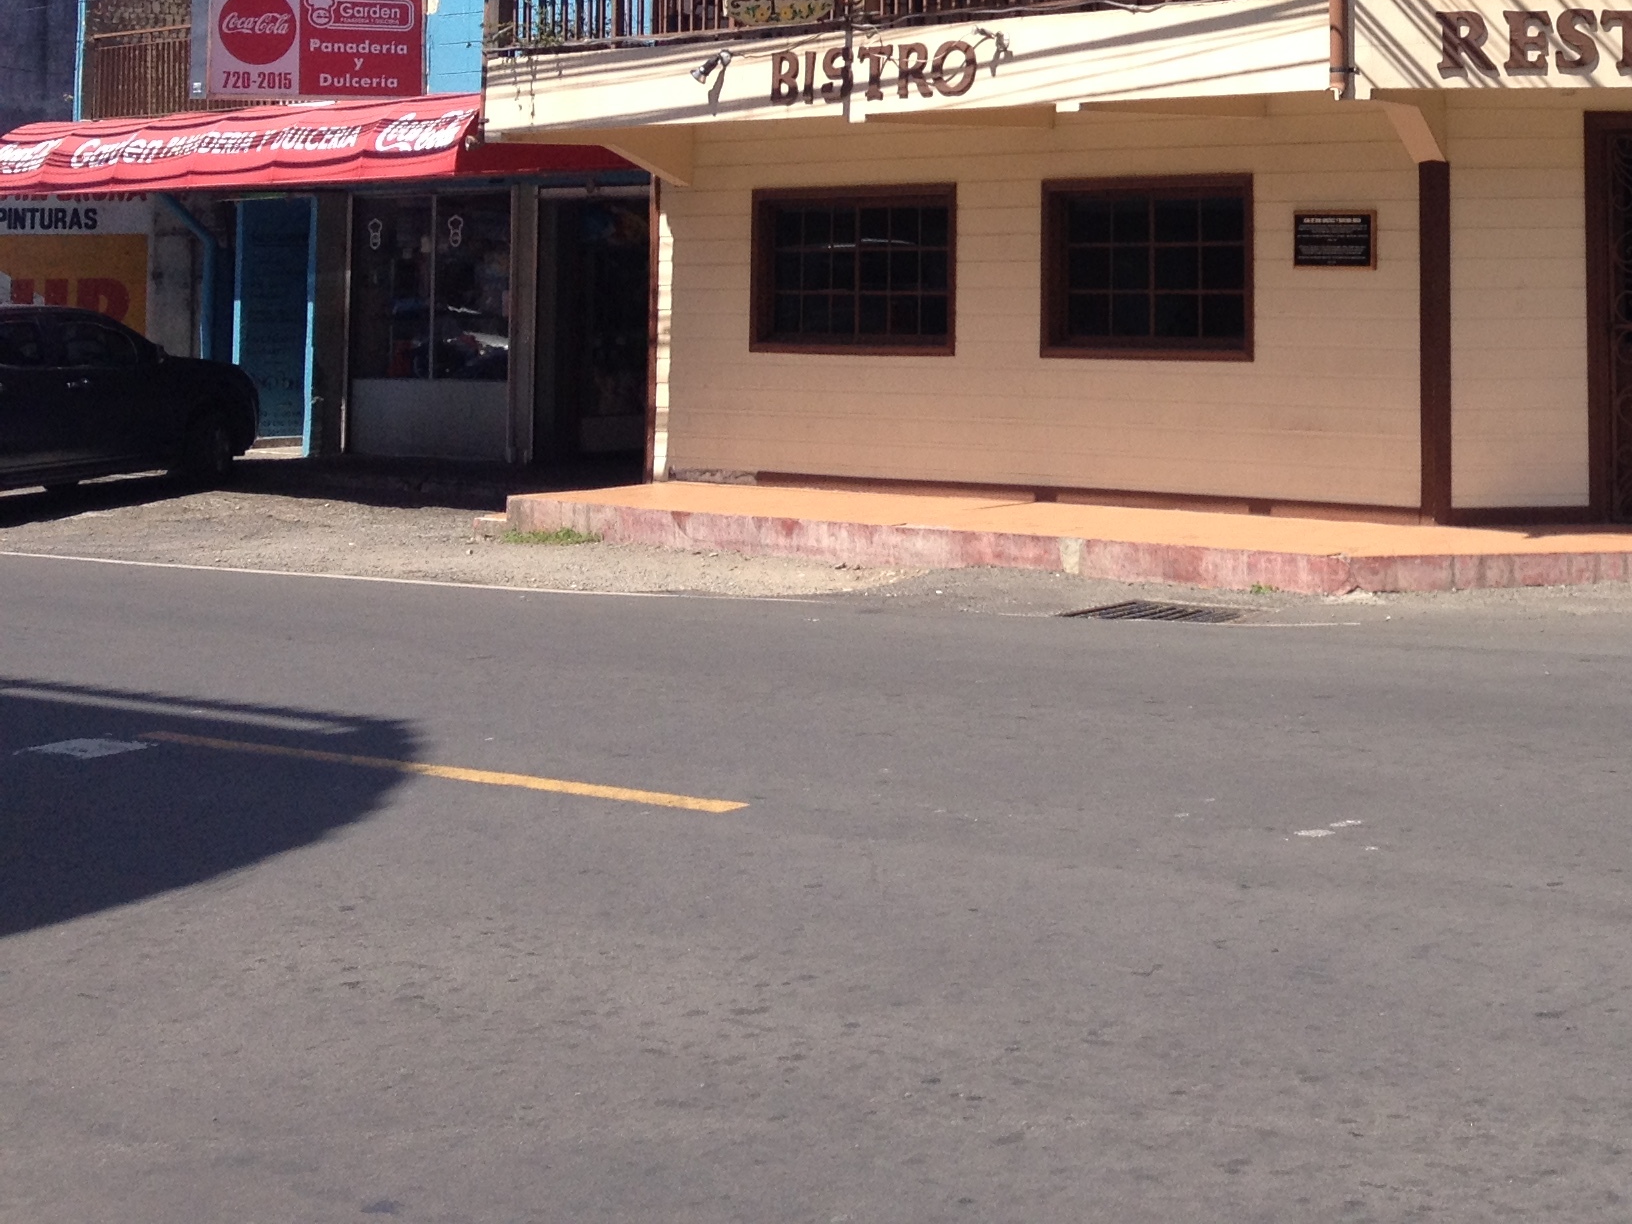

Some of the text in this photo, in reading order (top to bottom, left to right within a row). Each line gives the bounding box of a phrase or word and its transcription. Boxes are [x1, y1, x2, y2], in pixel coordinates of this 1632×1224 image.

[340, 3, 400, 18] Garden
[222, 11, 291, 35] Coca-Cola
[310, 38, 407, 54] Panadería
[354, 57, 363, 70] y
[222, 70, 292, 89] 720-2015
[319, 73, 398, 88] Dulcería
[770, 40, 977, 107] BISTRO
[0, 206, 98, 231] PINTURAS
